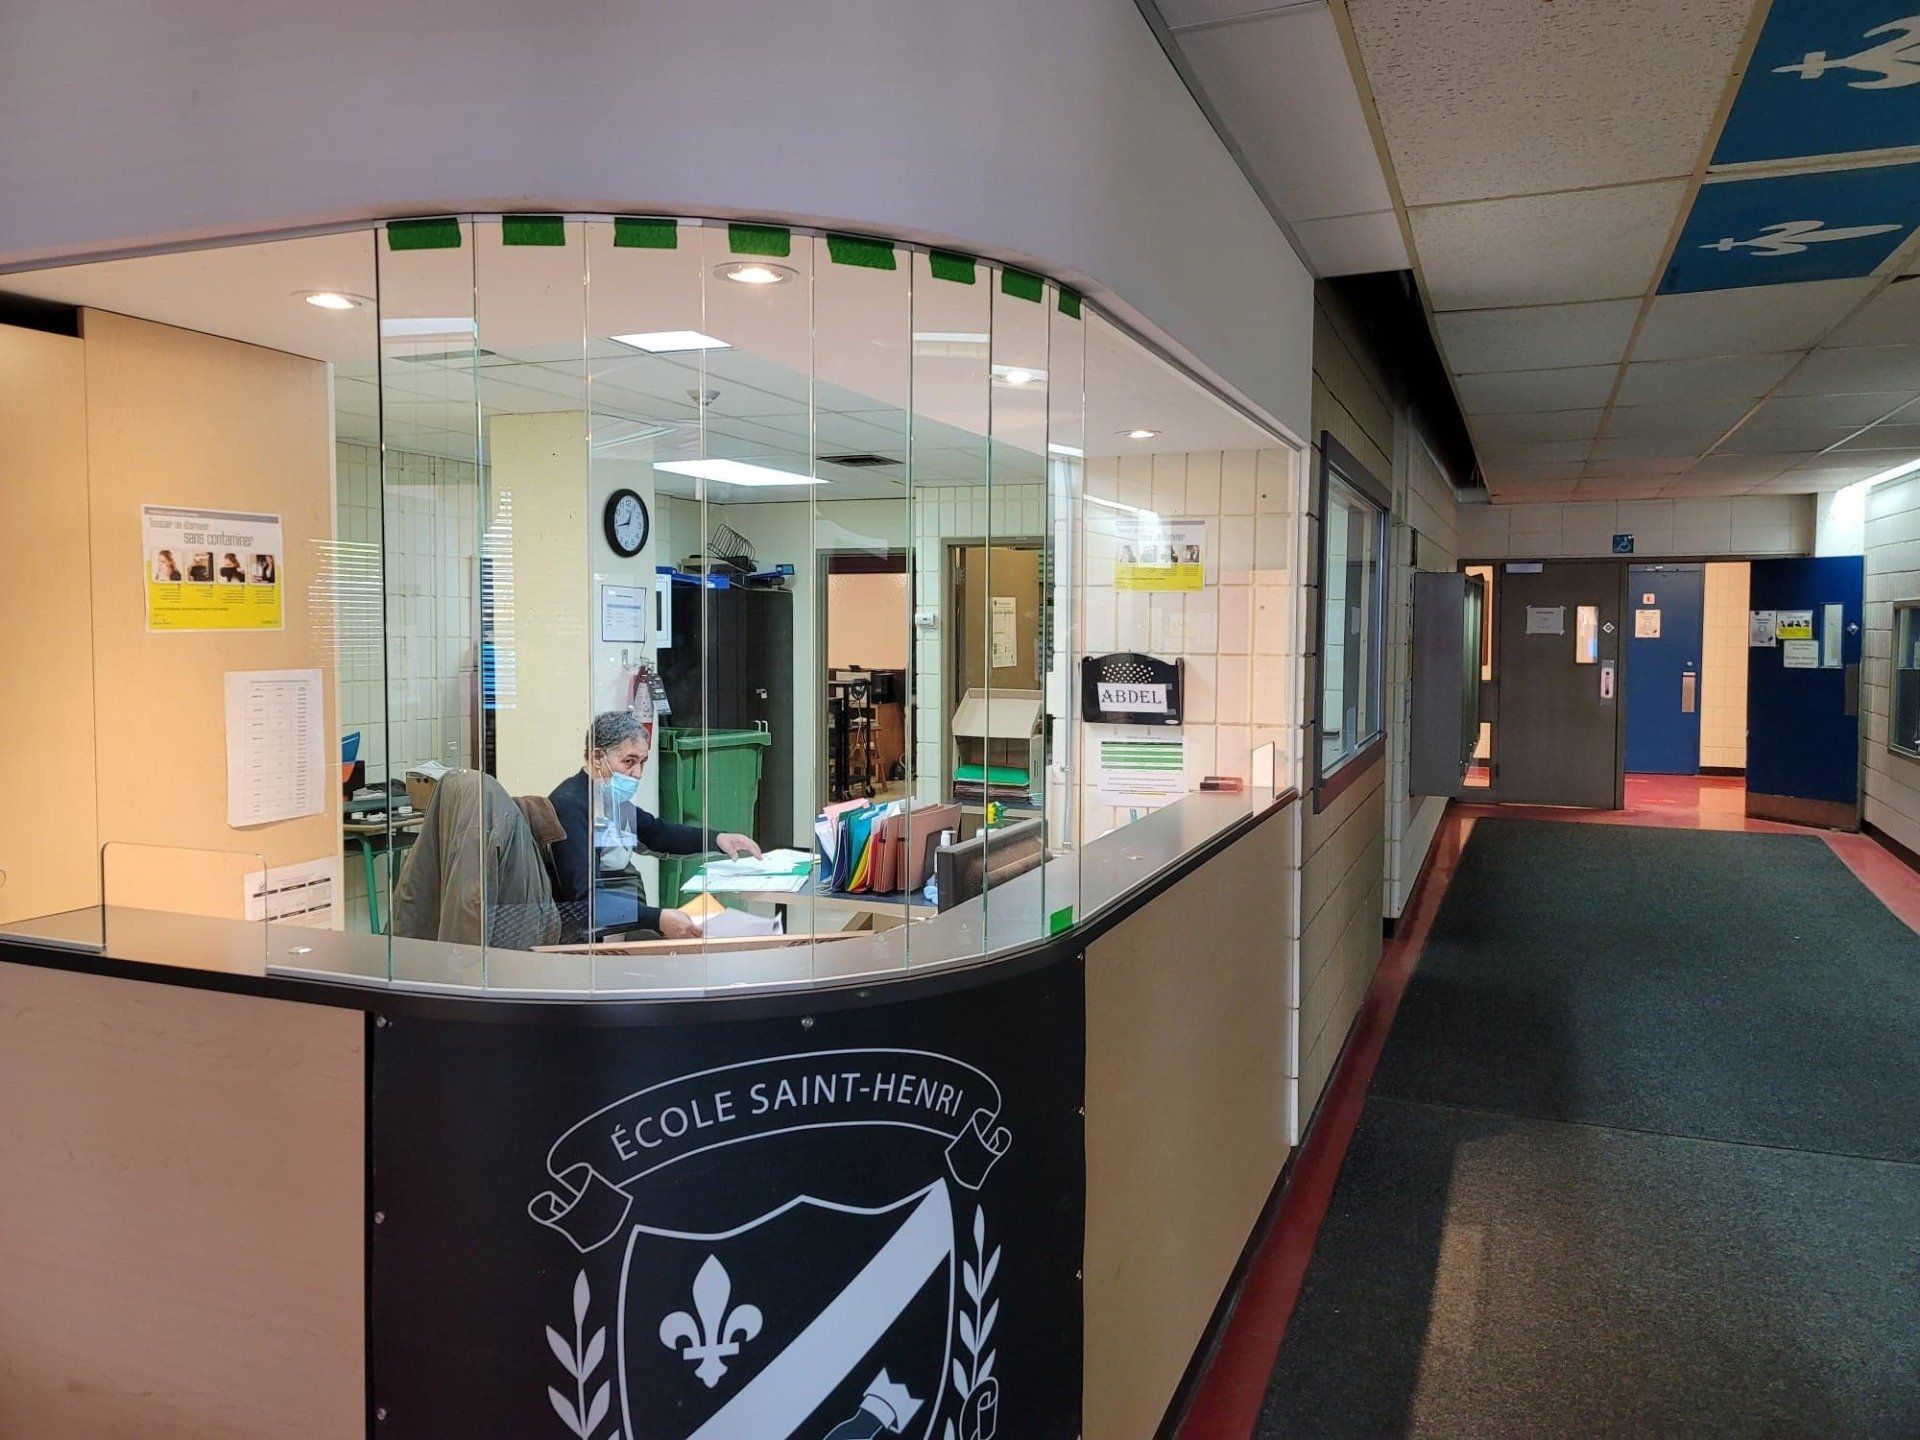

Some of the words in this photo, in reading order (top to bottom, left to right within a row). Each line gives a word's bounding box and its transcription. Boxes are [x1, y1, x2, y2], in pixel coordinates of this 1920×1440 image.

[625, 499, 632, 507] 12
[183, 532, 205, 544] sans
[206, 530, 254, 547] contaminer
[1101, 688, 1163, 705] ABDEL
[610, 1090, 736, 1162] ÉCOLE
[750, 1072, 964, 1117] SAINT-HENRI
